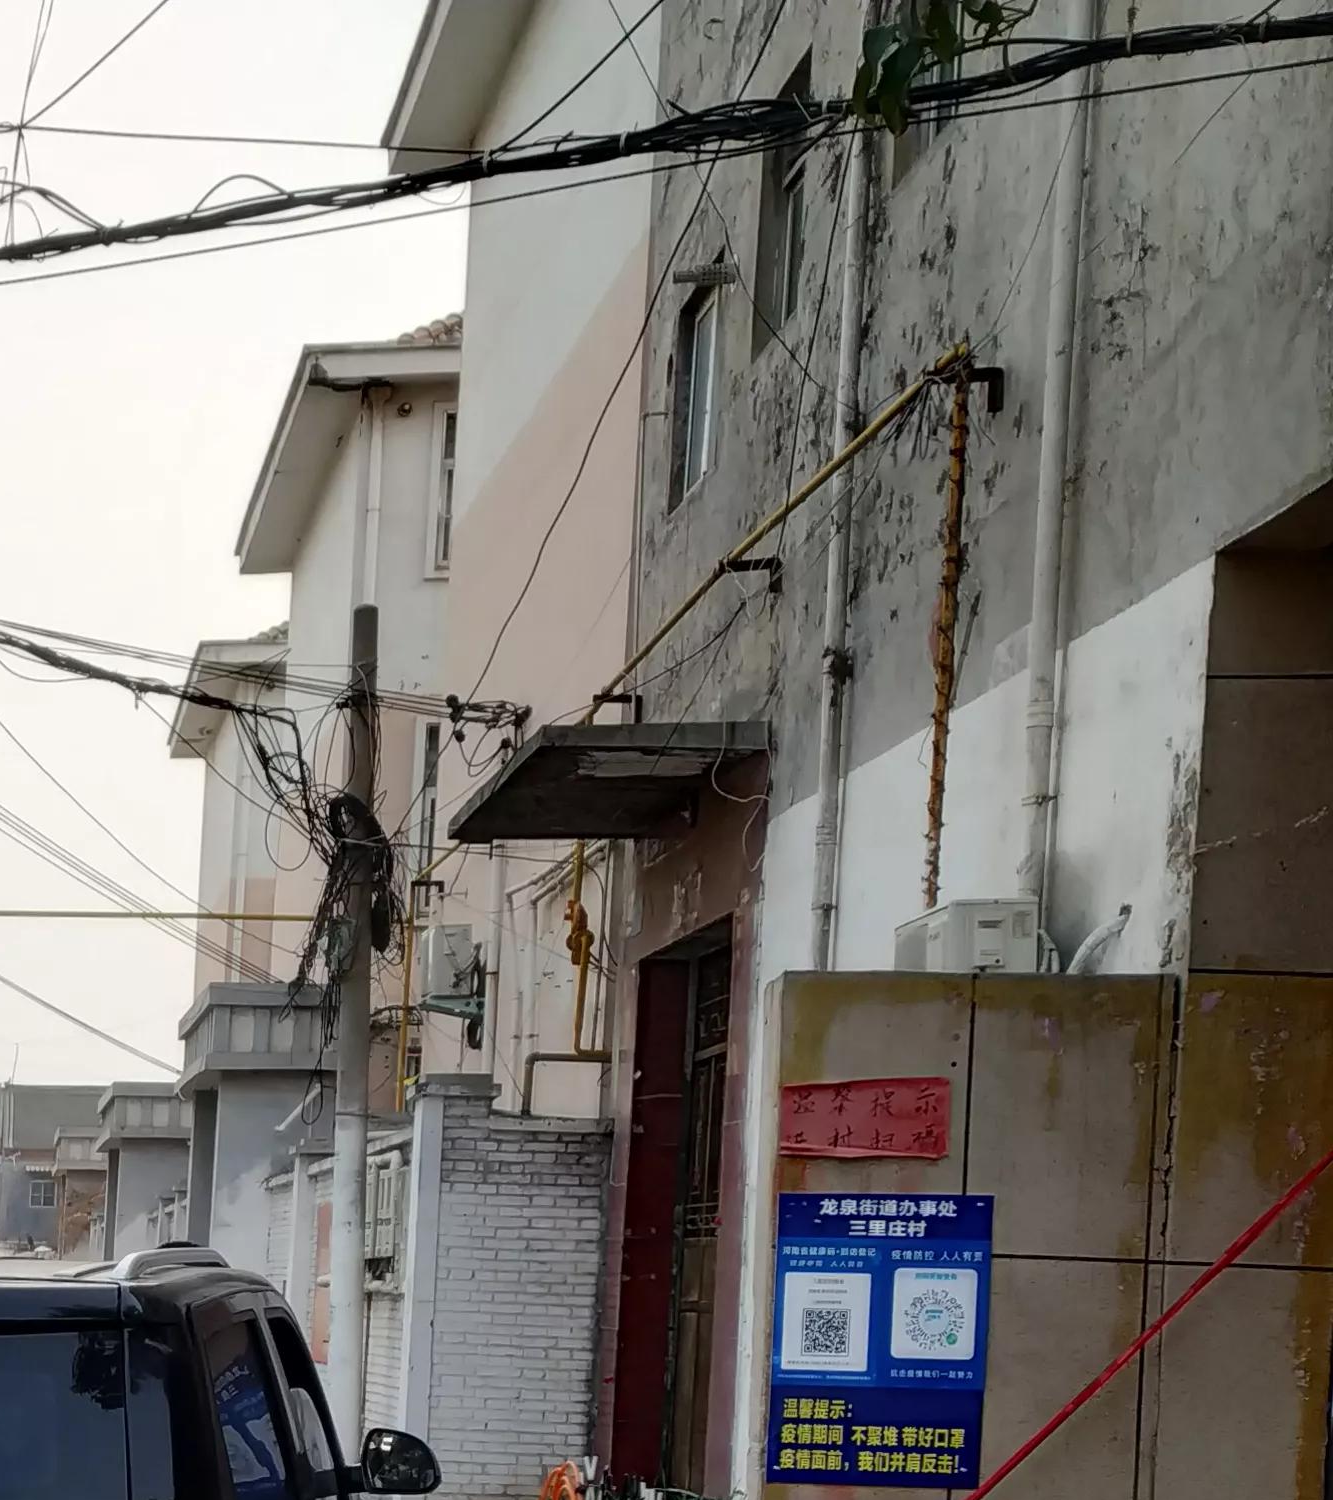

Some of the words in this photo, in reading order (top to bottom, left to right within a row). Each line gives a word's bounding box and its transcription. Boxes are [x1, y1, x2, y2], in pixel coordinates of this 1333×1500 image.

[819, 1198, 958, 1217] 龙泉街道办事处
[848, 1220, 927, 1237] 三里庄村
[784, 1398, 852, 1420] 温馨提示：
[781, 1424, 844, 1445] 疫情期间
[851, 1426, 898, 1447] 不聚堆
[902, 1427, 966, 1449] 带好口罩
